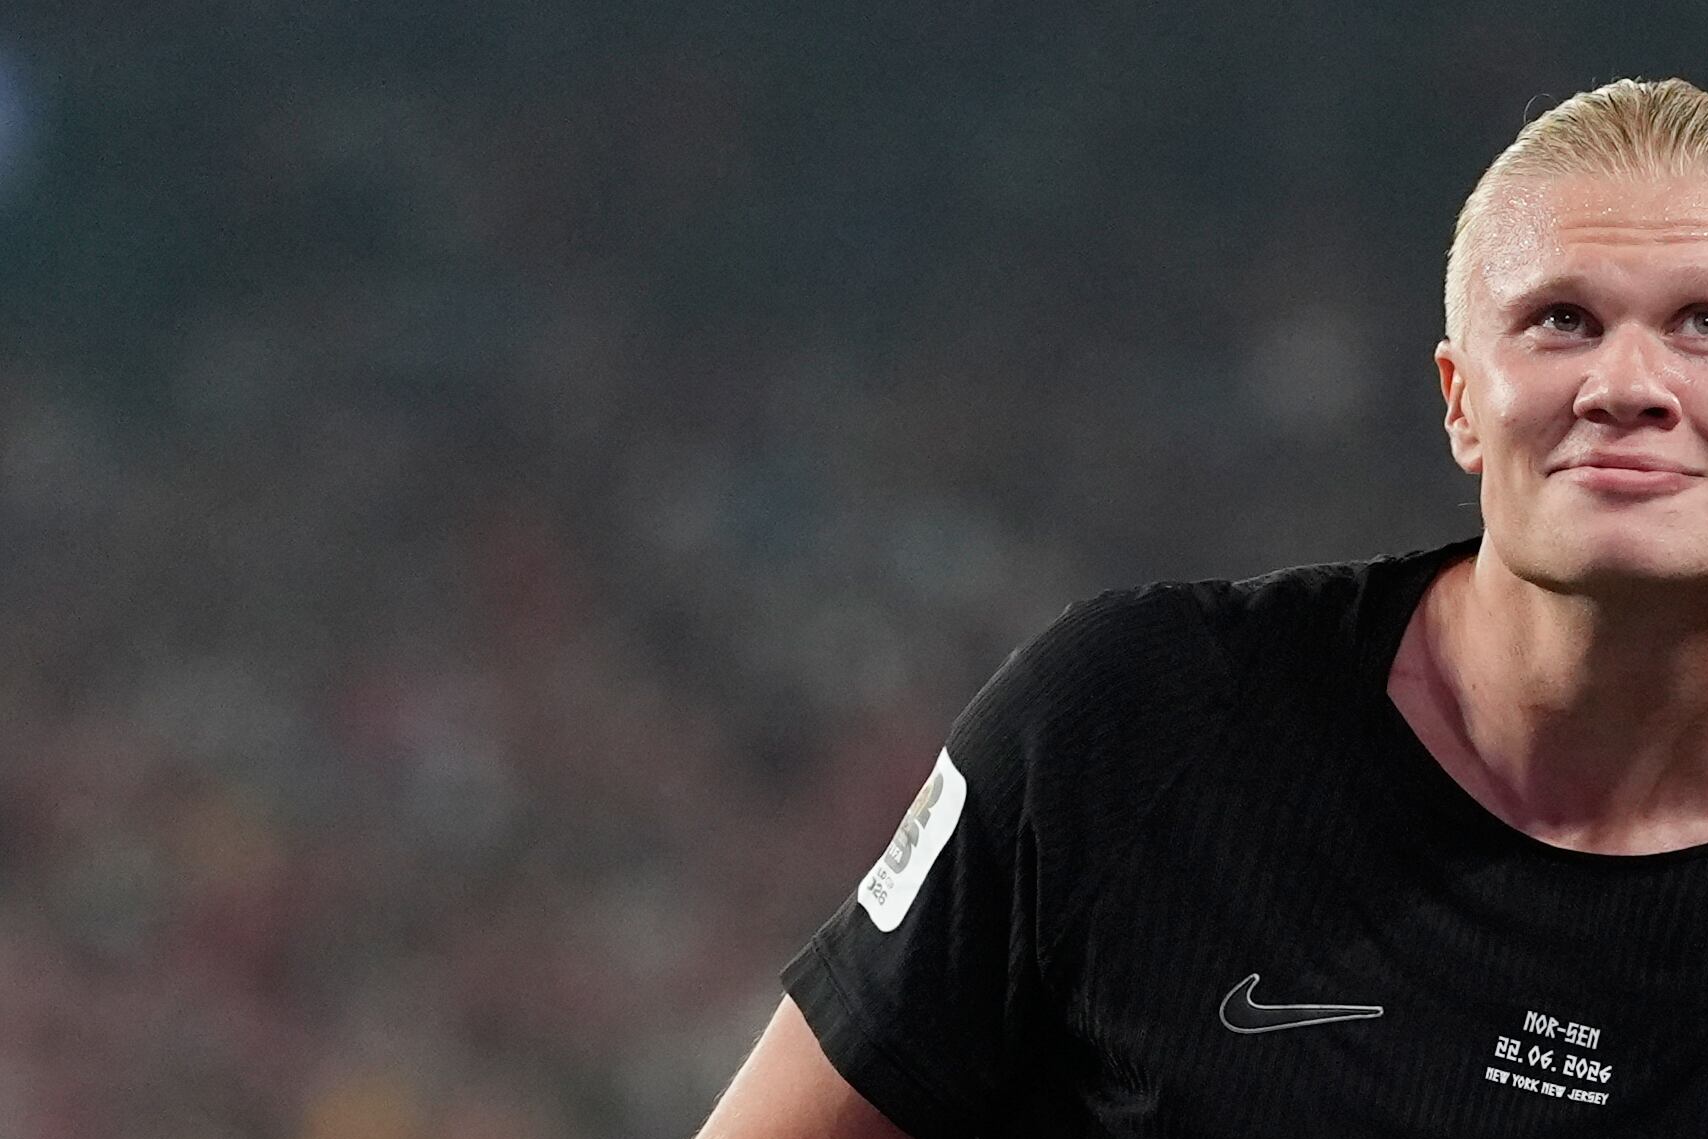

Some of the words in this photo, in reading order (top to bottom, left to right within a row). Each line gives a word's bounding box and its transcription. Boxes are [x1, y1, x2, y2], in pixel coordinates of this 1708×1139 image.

[1523, 1010, 1601, 1050] NOR-SEN
[1485, 1066, 1511, 1084] NEW
[1512, 1073, 1541, 1093] YORK
[1540, 1081, 1567, 1098] NEW
[1567, 1088, 1610, 1106] JERSEY
